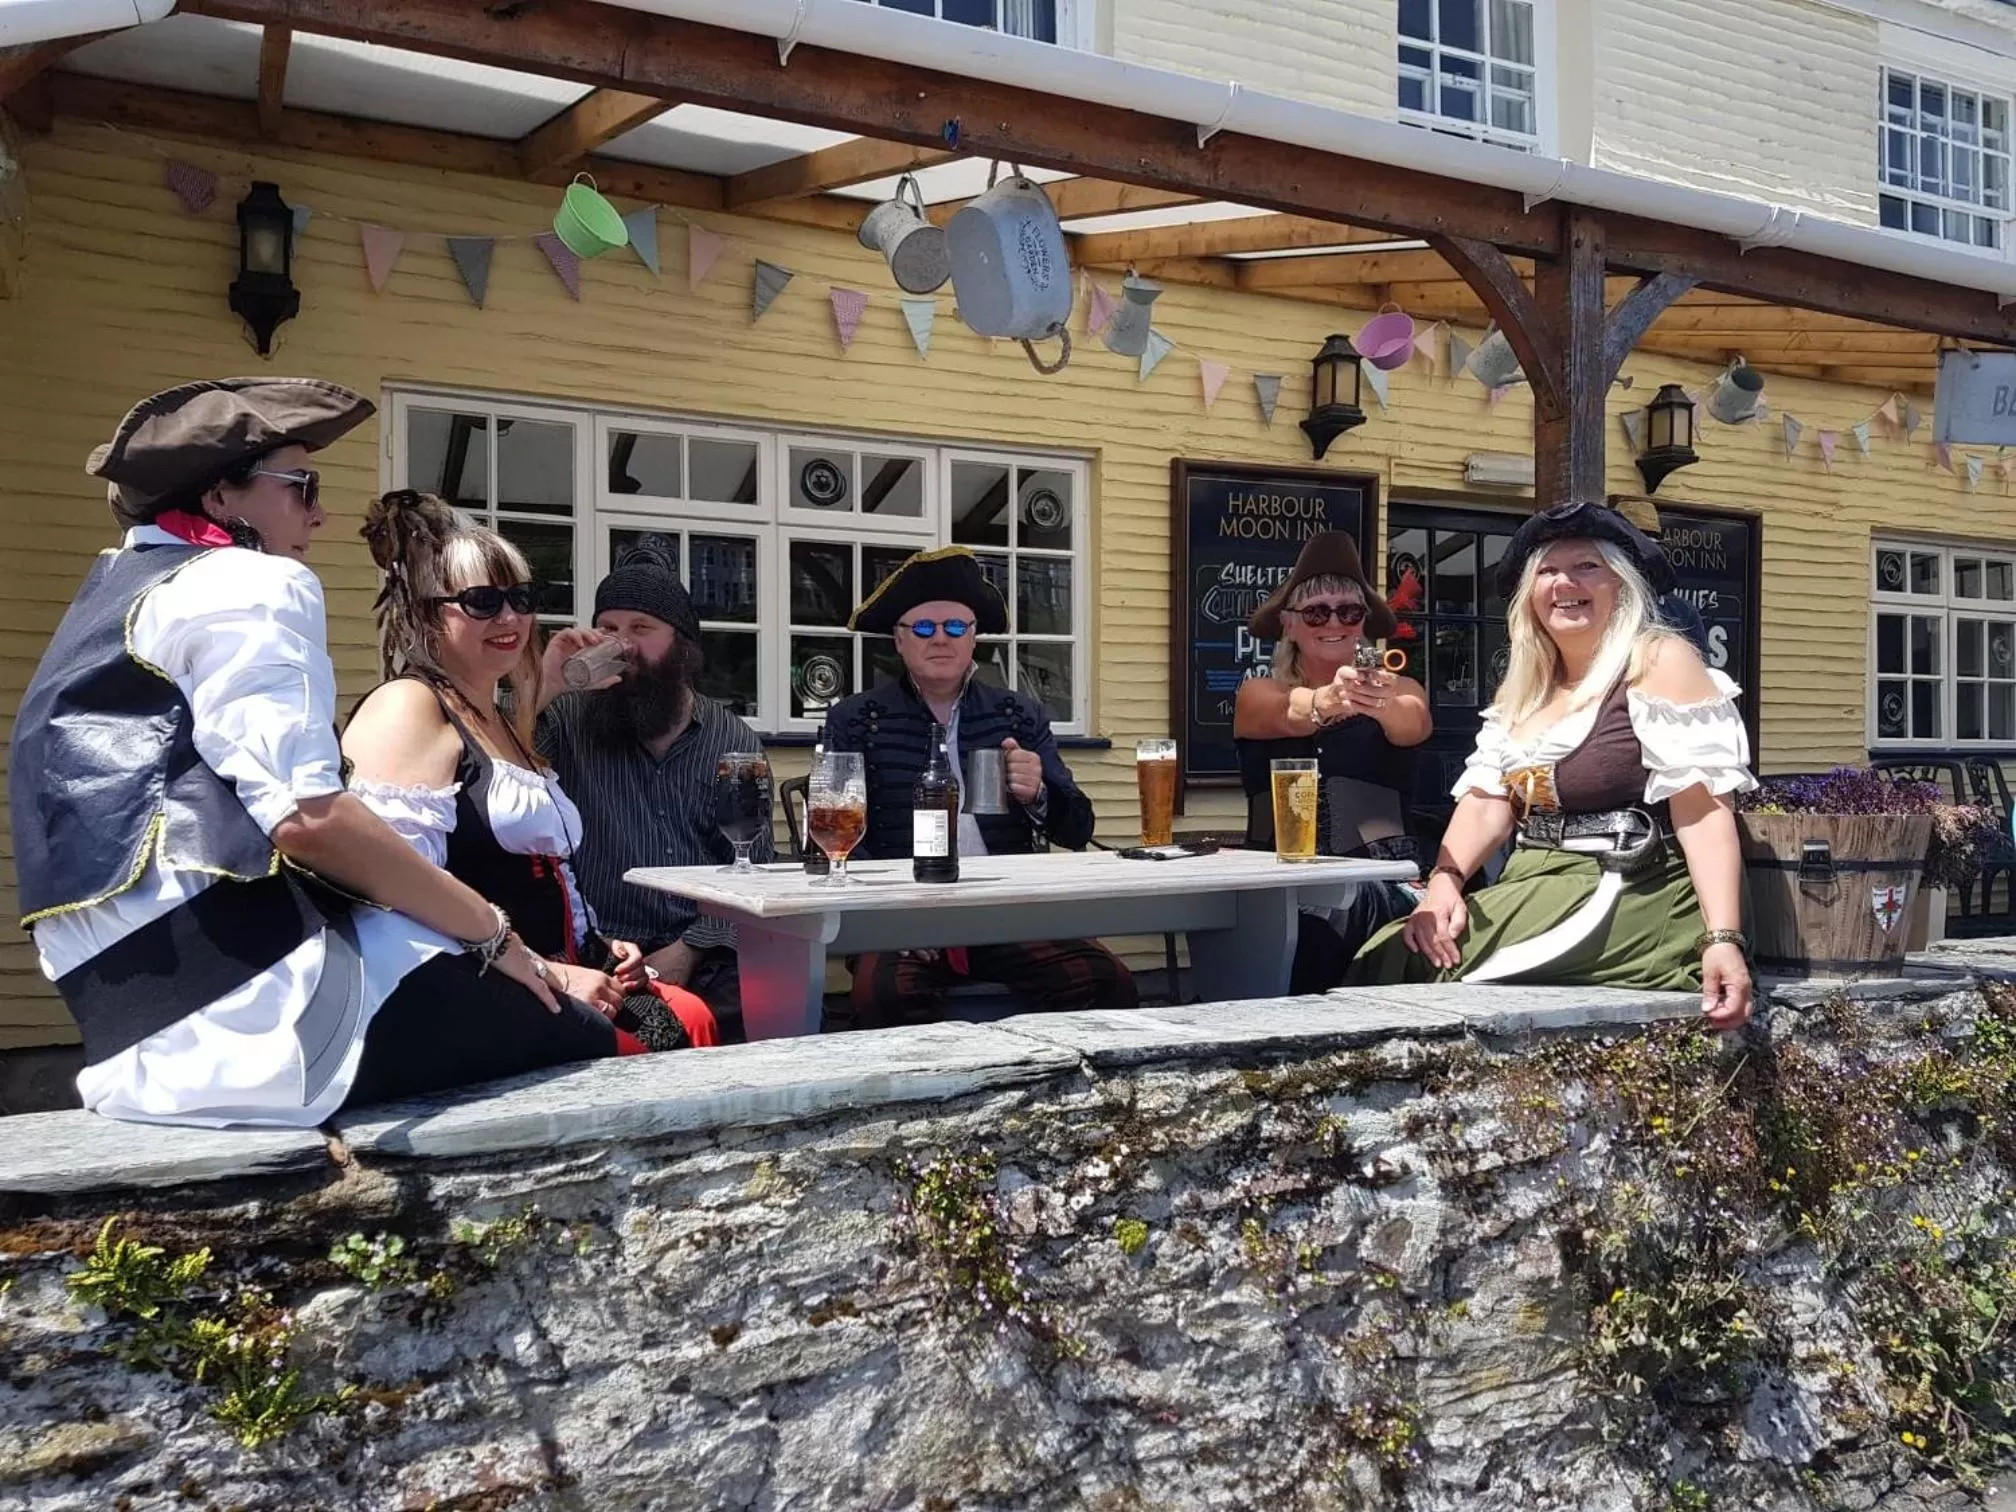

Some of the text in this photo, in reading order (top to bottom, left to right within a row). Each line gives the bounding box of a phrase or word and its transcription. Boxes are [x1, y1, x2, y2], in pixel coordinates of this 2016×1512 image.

[1228, 492, 1326, 520] HARBOUR
[1218, 515, 1290, 540] MOON
[1662, 527, 1724, 550] ARBOUR
[1700, 550, 1727, 571] INN
[1219, 562, 1295, 585] SHELTE
